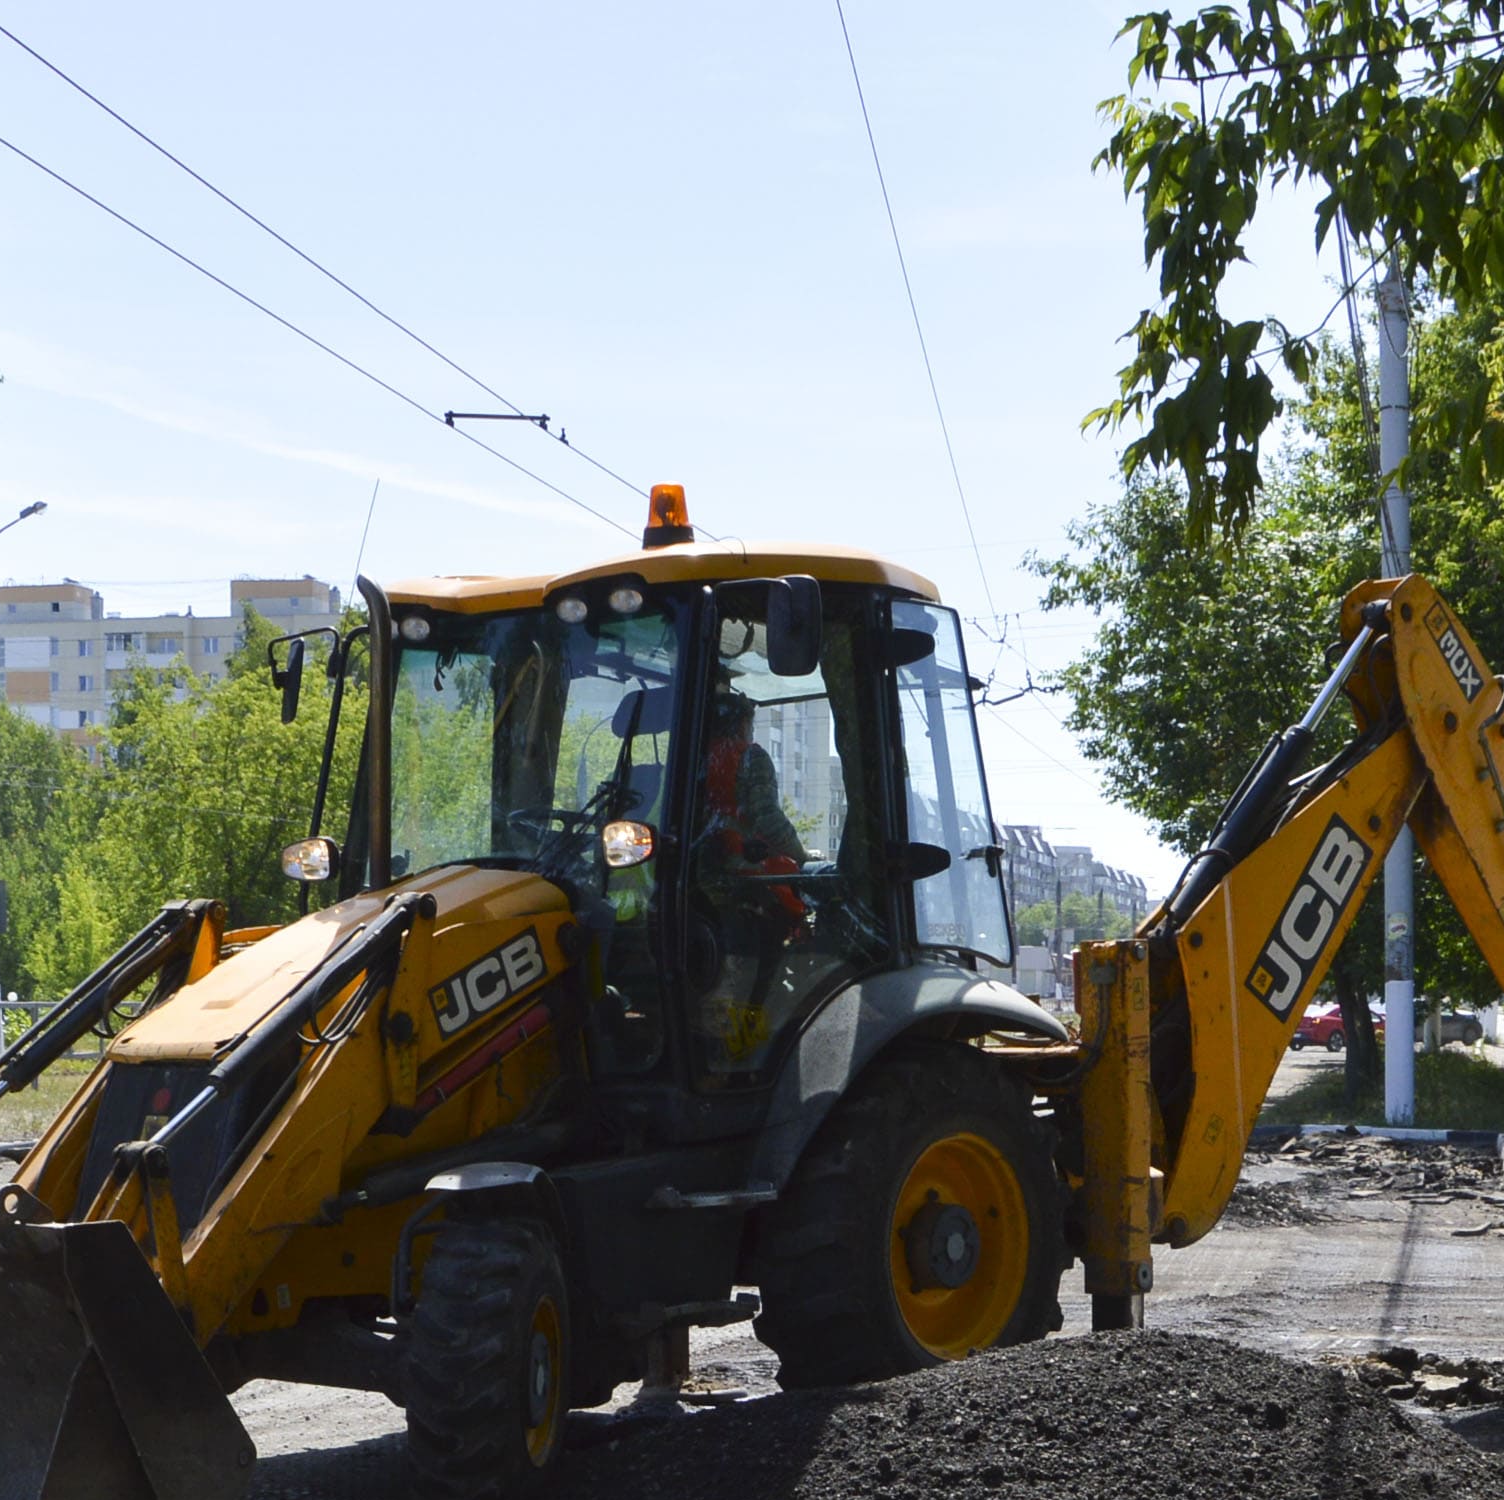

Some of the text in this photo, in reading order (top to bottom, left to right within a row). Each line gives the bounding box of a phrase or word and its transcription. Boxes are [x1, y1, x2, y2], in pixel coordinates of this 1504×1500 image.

[1439, 629, 1481, 699] 3CX
[1265, 826, 1365, 1012] JCB
[438, 934, 544, 1033] JCB
